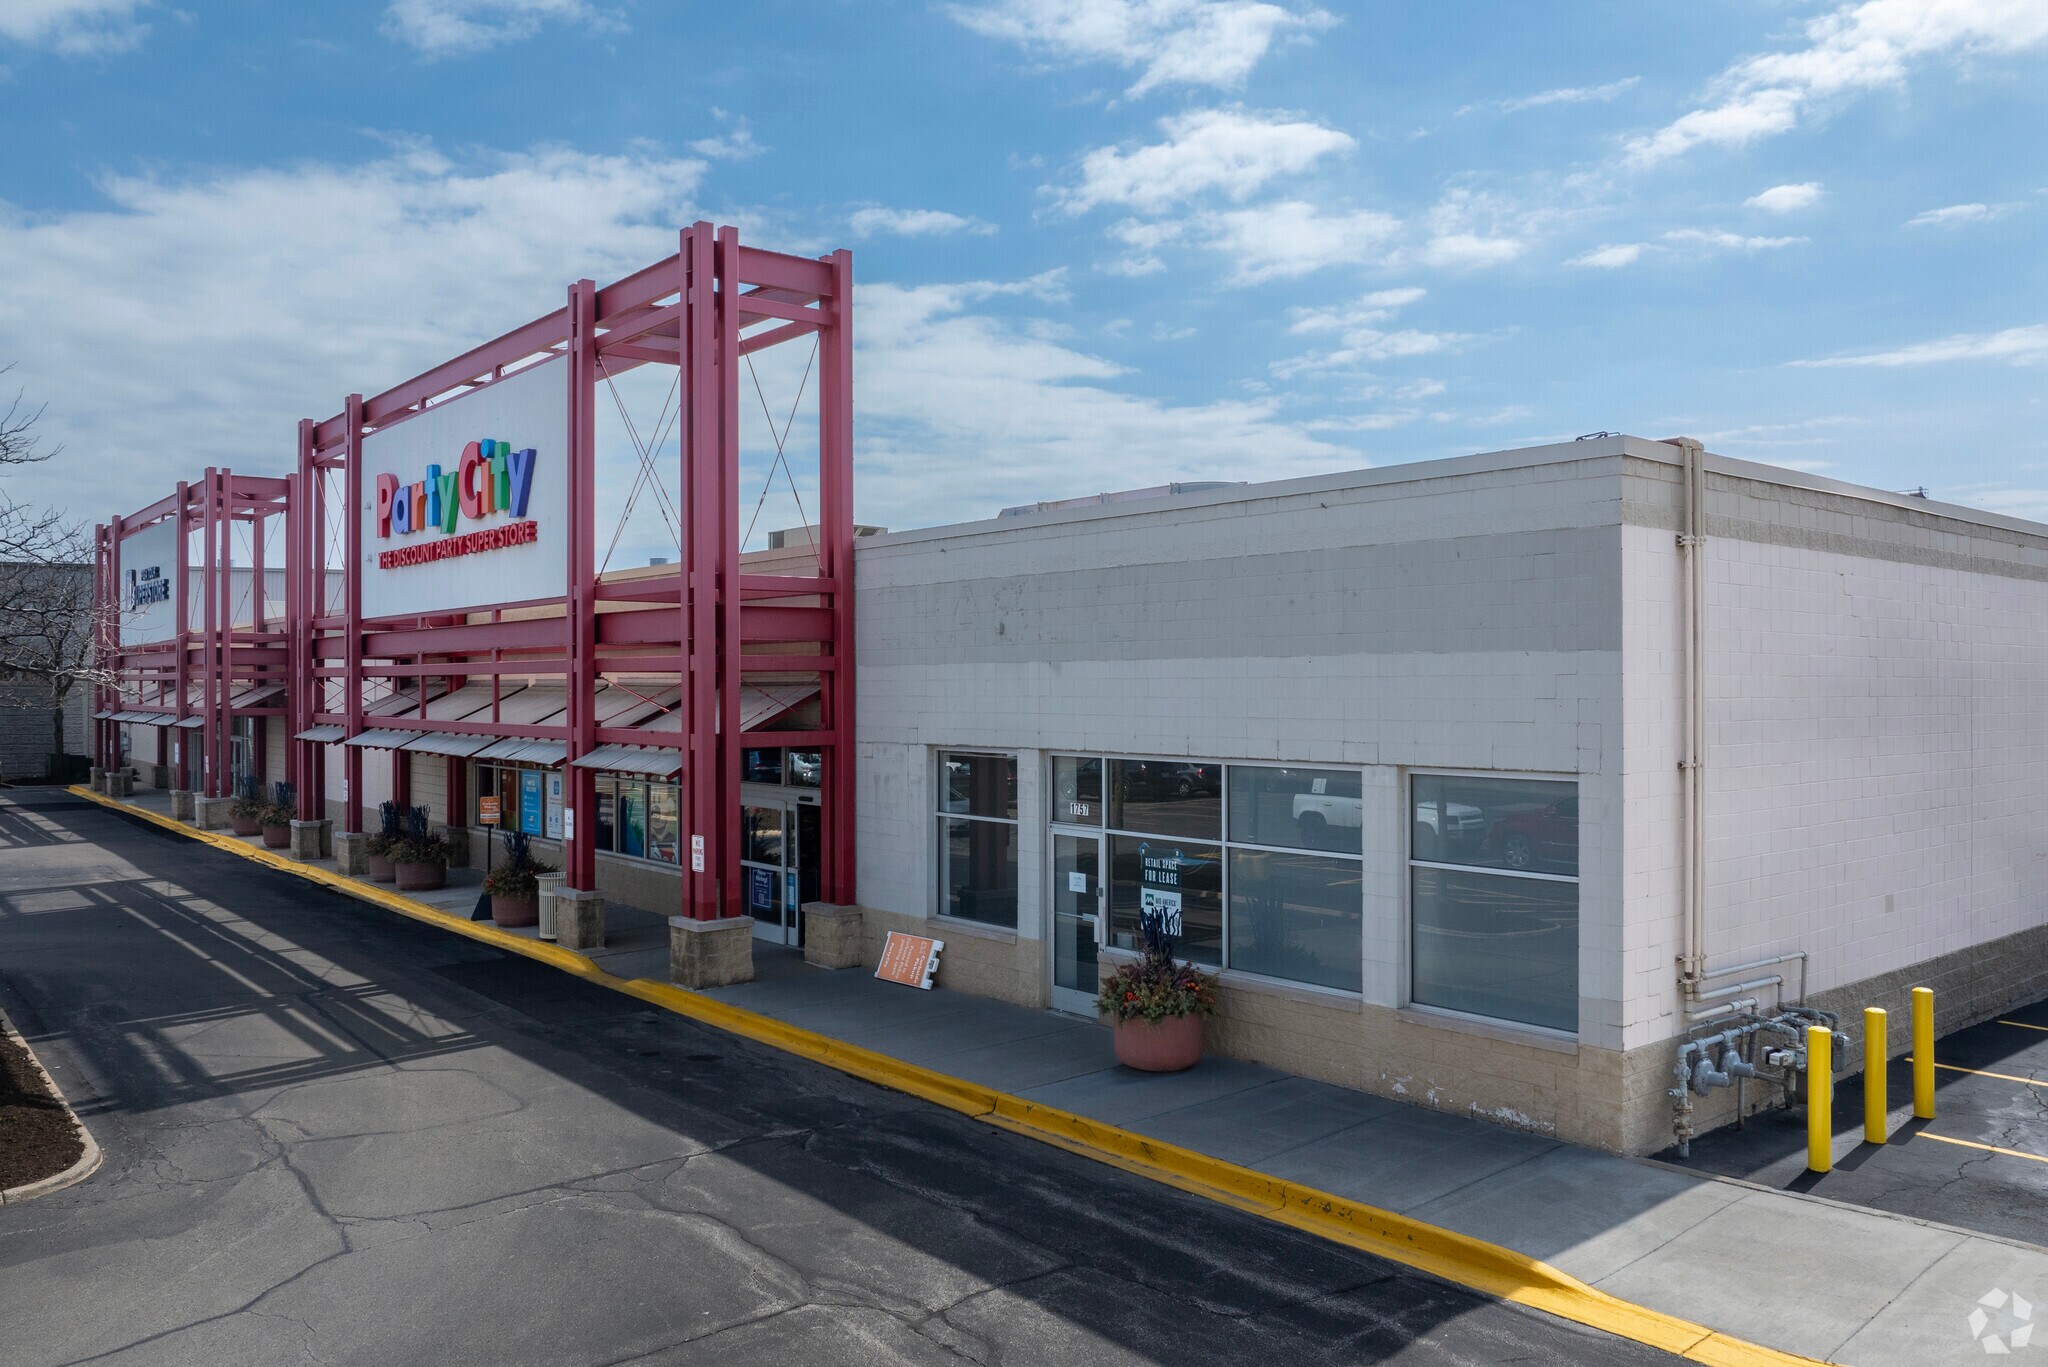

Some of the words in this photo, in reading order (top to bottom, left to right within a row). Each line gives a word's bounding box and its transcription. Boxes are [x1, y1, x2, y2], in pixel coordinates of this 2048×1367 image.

[378, 550, 393, 569] THE
[393, 542, 435, 567] DISCOUNT
[435, 535, 464, 560] PARTY
[465, 529, 497, 554] SUPER
[498, 520, 536, 548] STORE
[1071, 803, 1088, 815] 1757
[1145, 858, 1161, 868] RETAIL
[1162, 859, 1178, 871] SPACE
[1145, 869, 1157, 882] FOR
[1158, 871, 1178, 885] LEASE
